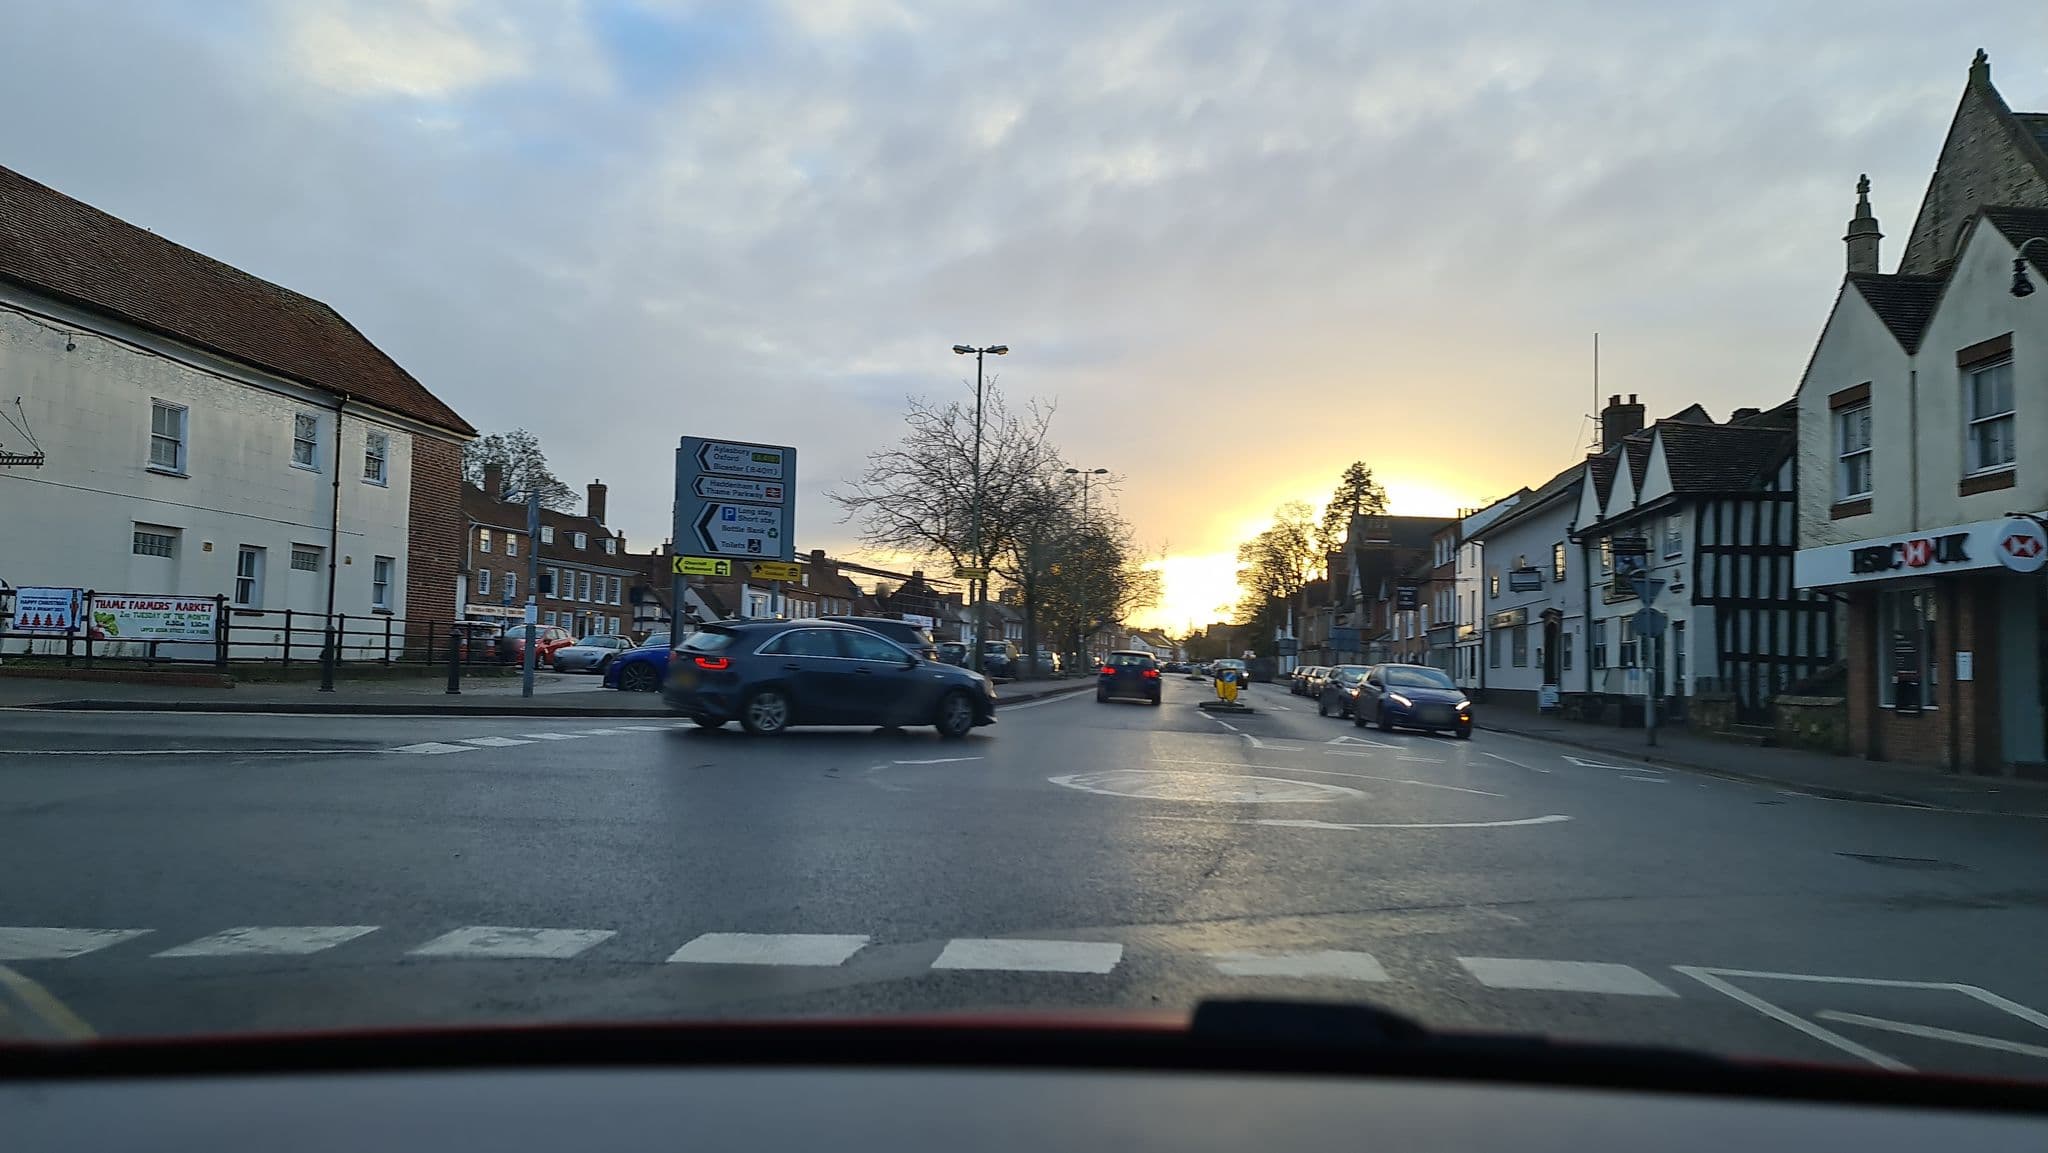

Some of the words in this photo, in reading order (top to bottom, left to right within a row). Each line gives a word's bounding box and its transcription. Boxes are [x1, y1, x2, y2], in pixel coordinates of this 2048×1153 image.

[713, 445, 750, 456] Aylesbury
[713, 453, 740, 462] Oxford
[713, 463, 744, 472] Bicester
[709, 480, 753, 489] Haddenham
[705, 487, 731, 496] Thame
[732, 489, 764, 499] Parkway
[737, 507, 756, 516] Long
[758, 508, 773, 517] stay
[737, 514, 758, 523] Short
[760, 517, 776, 525] stay
[721, 525, 745, 533] Bottle
[746, 526, 766, 534] Bank
[720, 541, 746, 549] Toilets
[94, 599, 127, 610] THAME
[175, 602, 214, 612] MARKET
[187, 613, 211, 621] MONTH
